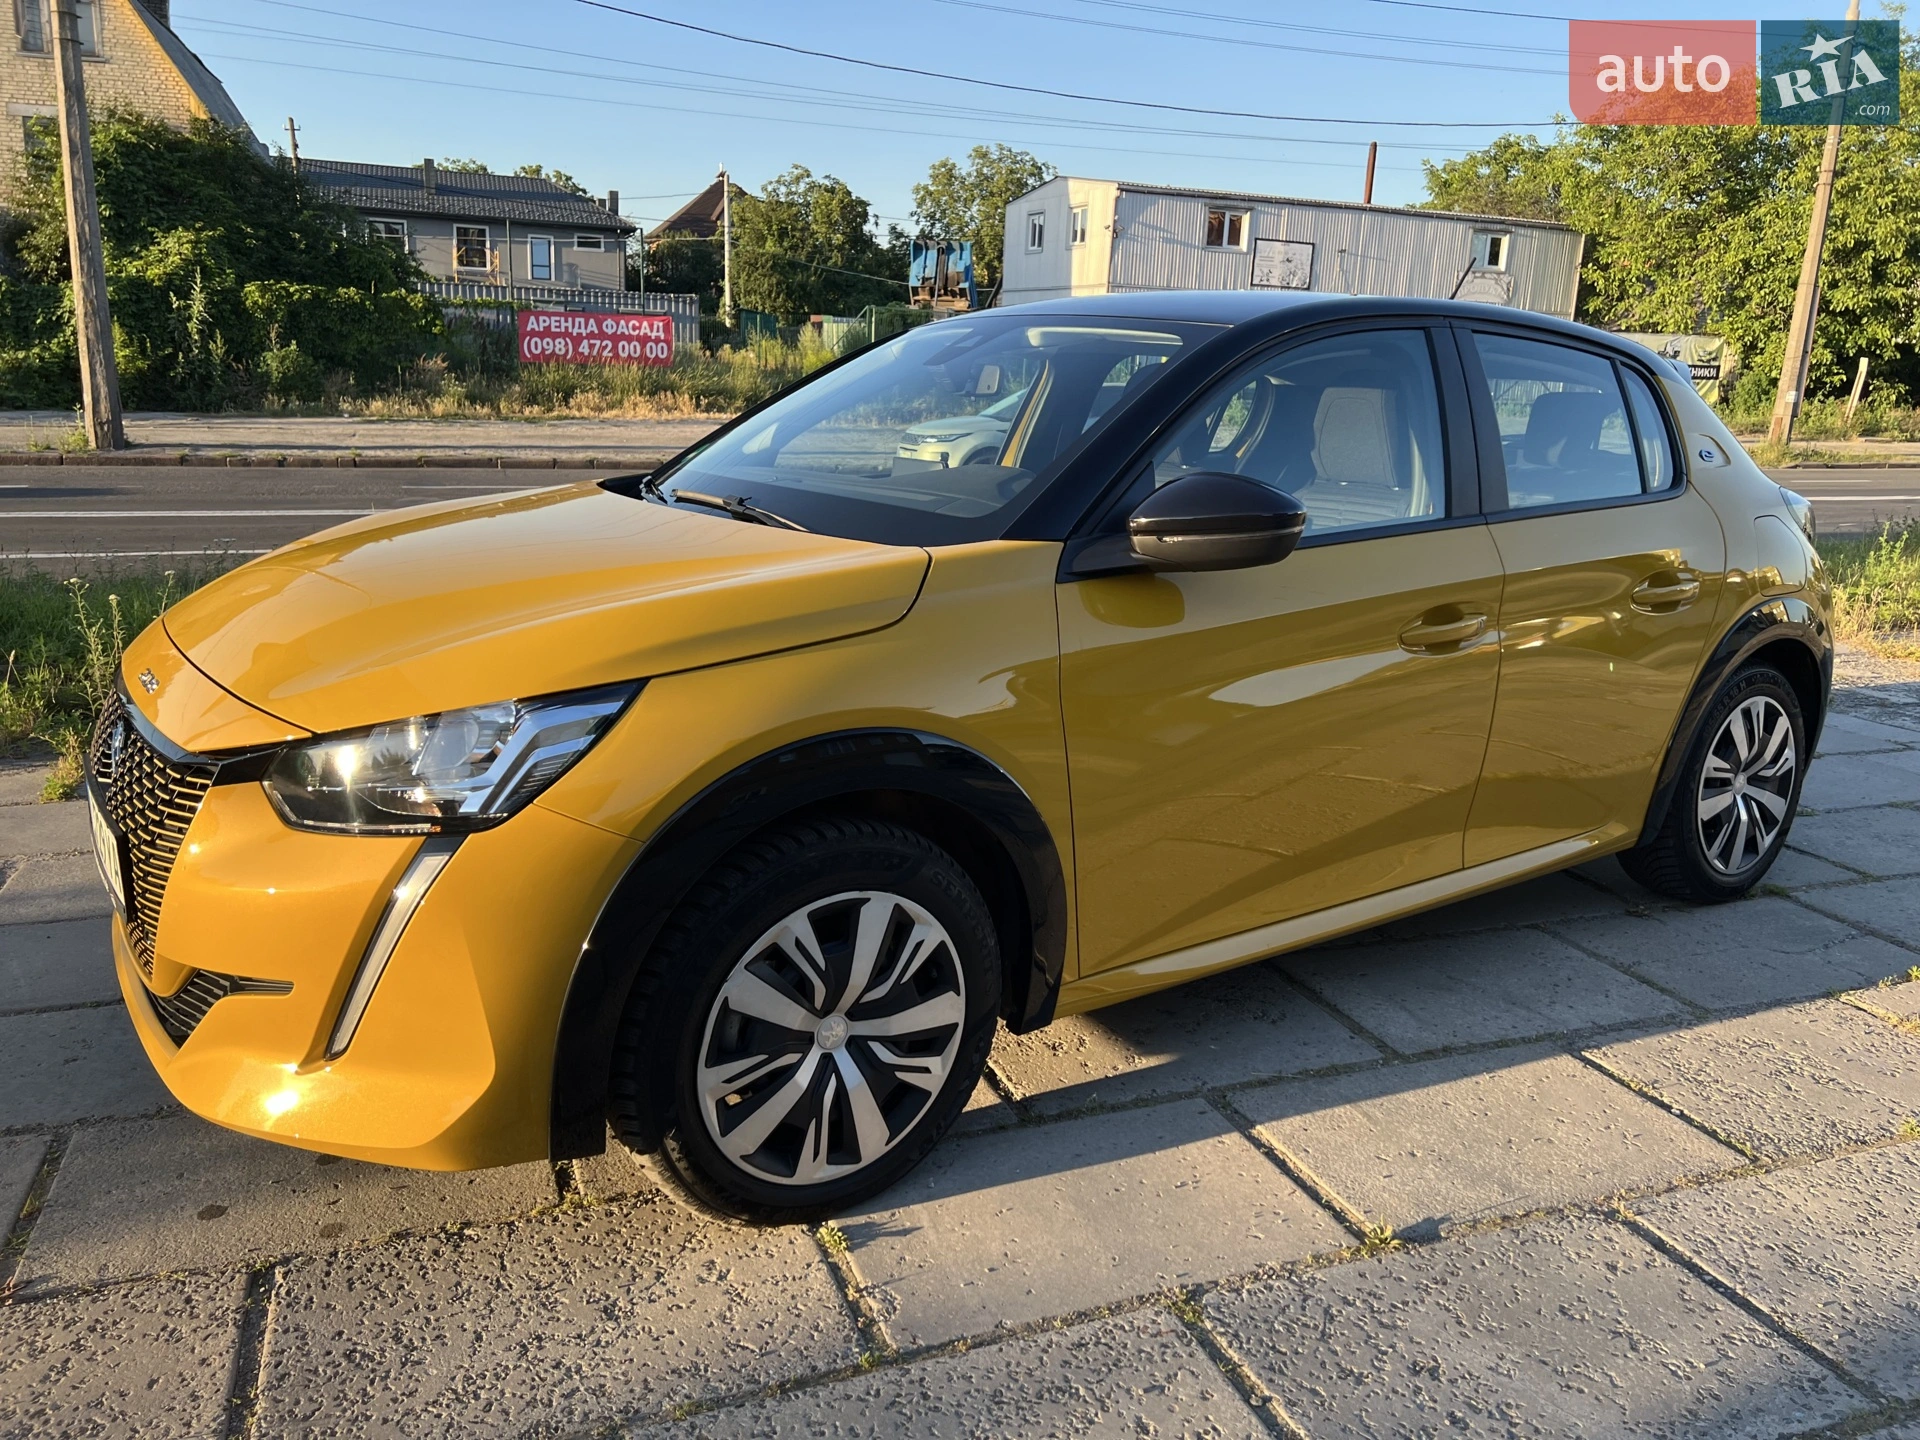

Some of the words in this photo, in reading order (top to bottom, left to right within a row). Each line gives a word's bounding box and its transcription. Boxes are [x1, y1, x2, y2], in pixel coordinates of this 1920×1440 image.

[526, 315, 598, 336] АРЕНДА
[602, 318, 665, 339] ФАСАД
[523, 335, 573, 359] (098)
[578, 339, 613, 357] 472
[618, 340, 640, 358] 00
[646, 341, 668, 359] 00
